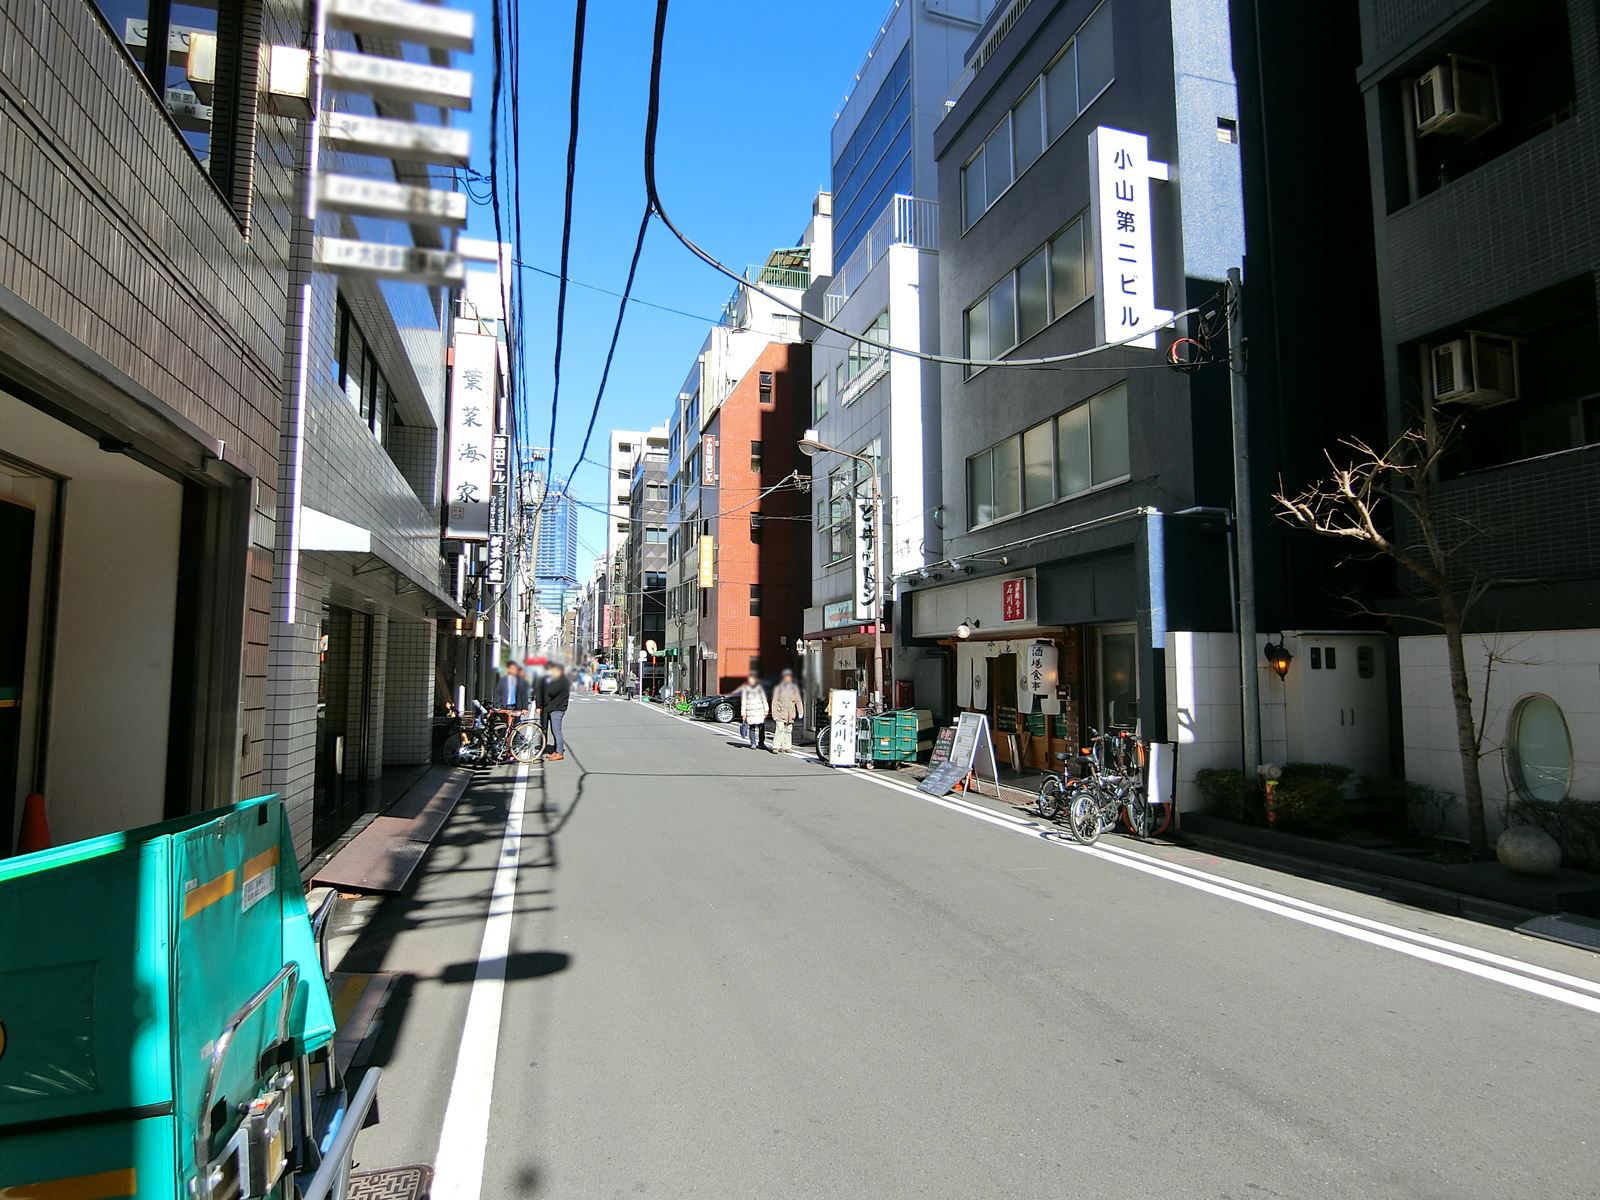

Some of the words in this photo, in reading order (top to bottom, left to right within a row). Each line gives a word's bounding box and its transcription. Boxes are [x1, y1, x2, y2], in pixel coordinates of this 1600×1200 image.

[1113, 148, 1140, 327] 小山第二ビル
[456, 367, 487, 504] 葉菜海家
[1030, 645, 1043, 691] 酒場食事
[833, 714, 848, 758] 石川亭
